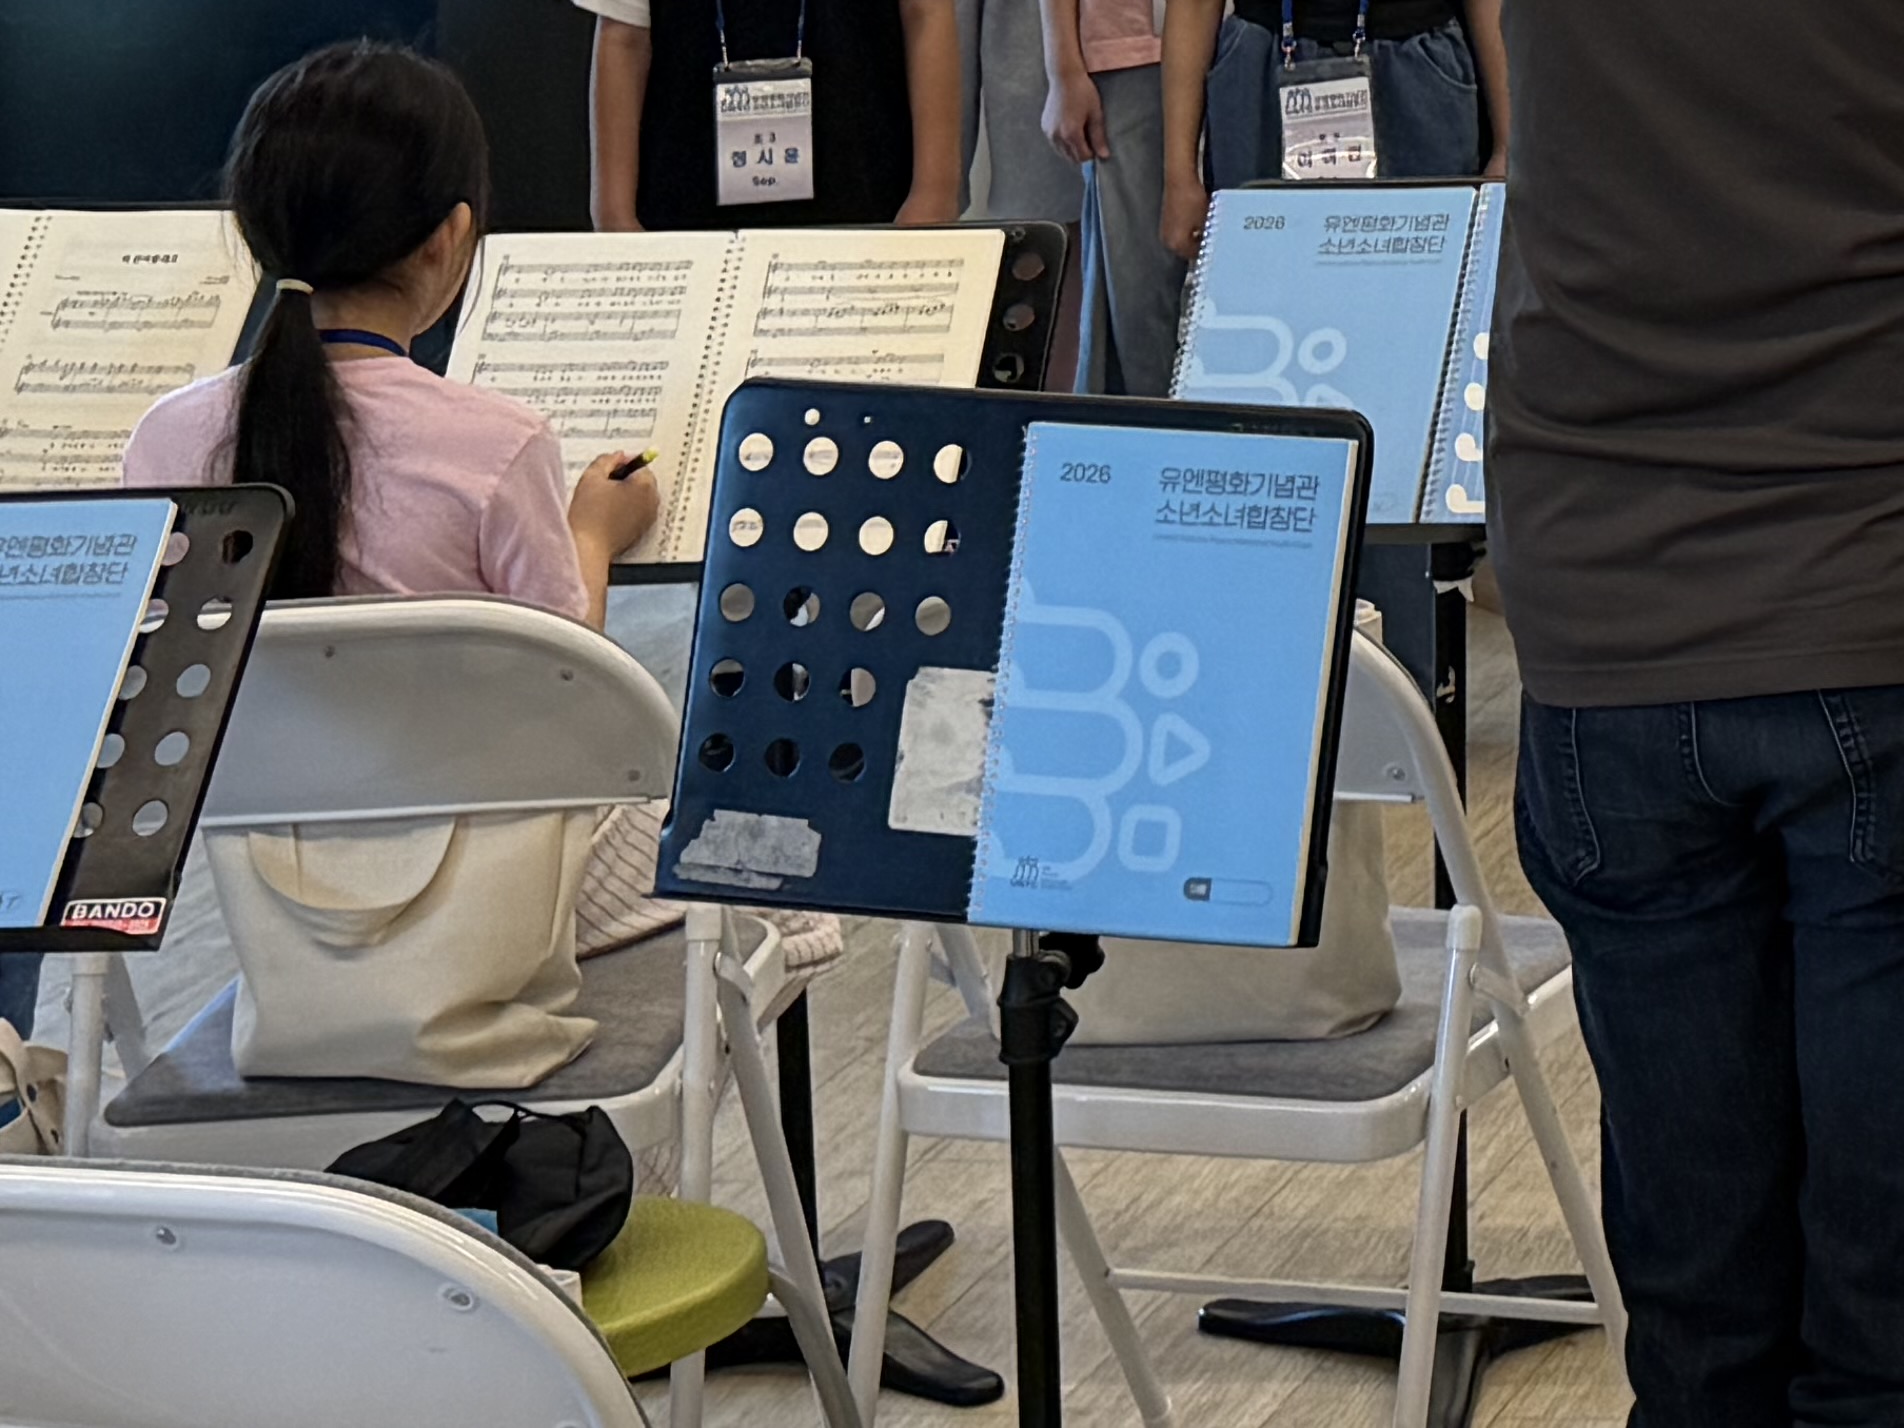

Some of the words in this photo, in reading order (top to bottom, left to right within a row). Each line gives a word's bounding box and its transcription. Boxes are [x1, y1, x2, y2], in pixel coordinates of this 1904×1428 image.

[1059, 462, 1112, 485] 2026
[1158, 466, 1320, 502] 유엔평화기념관
[1154, 500, 1318, 534] 소년소녀합창단
[0, 533, 138, 559] 엔평화기념관
[0, 561, 129, 585] 년소녀합창단
[71, 901, 156, 920] BANDO
